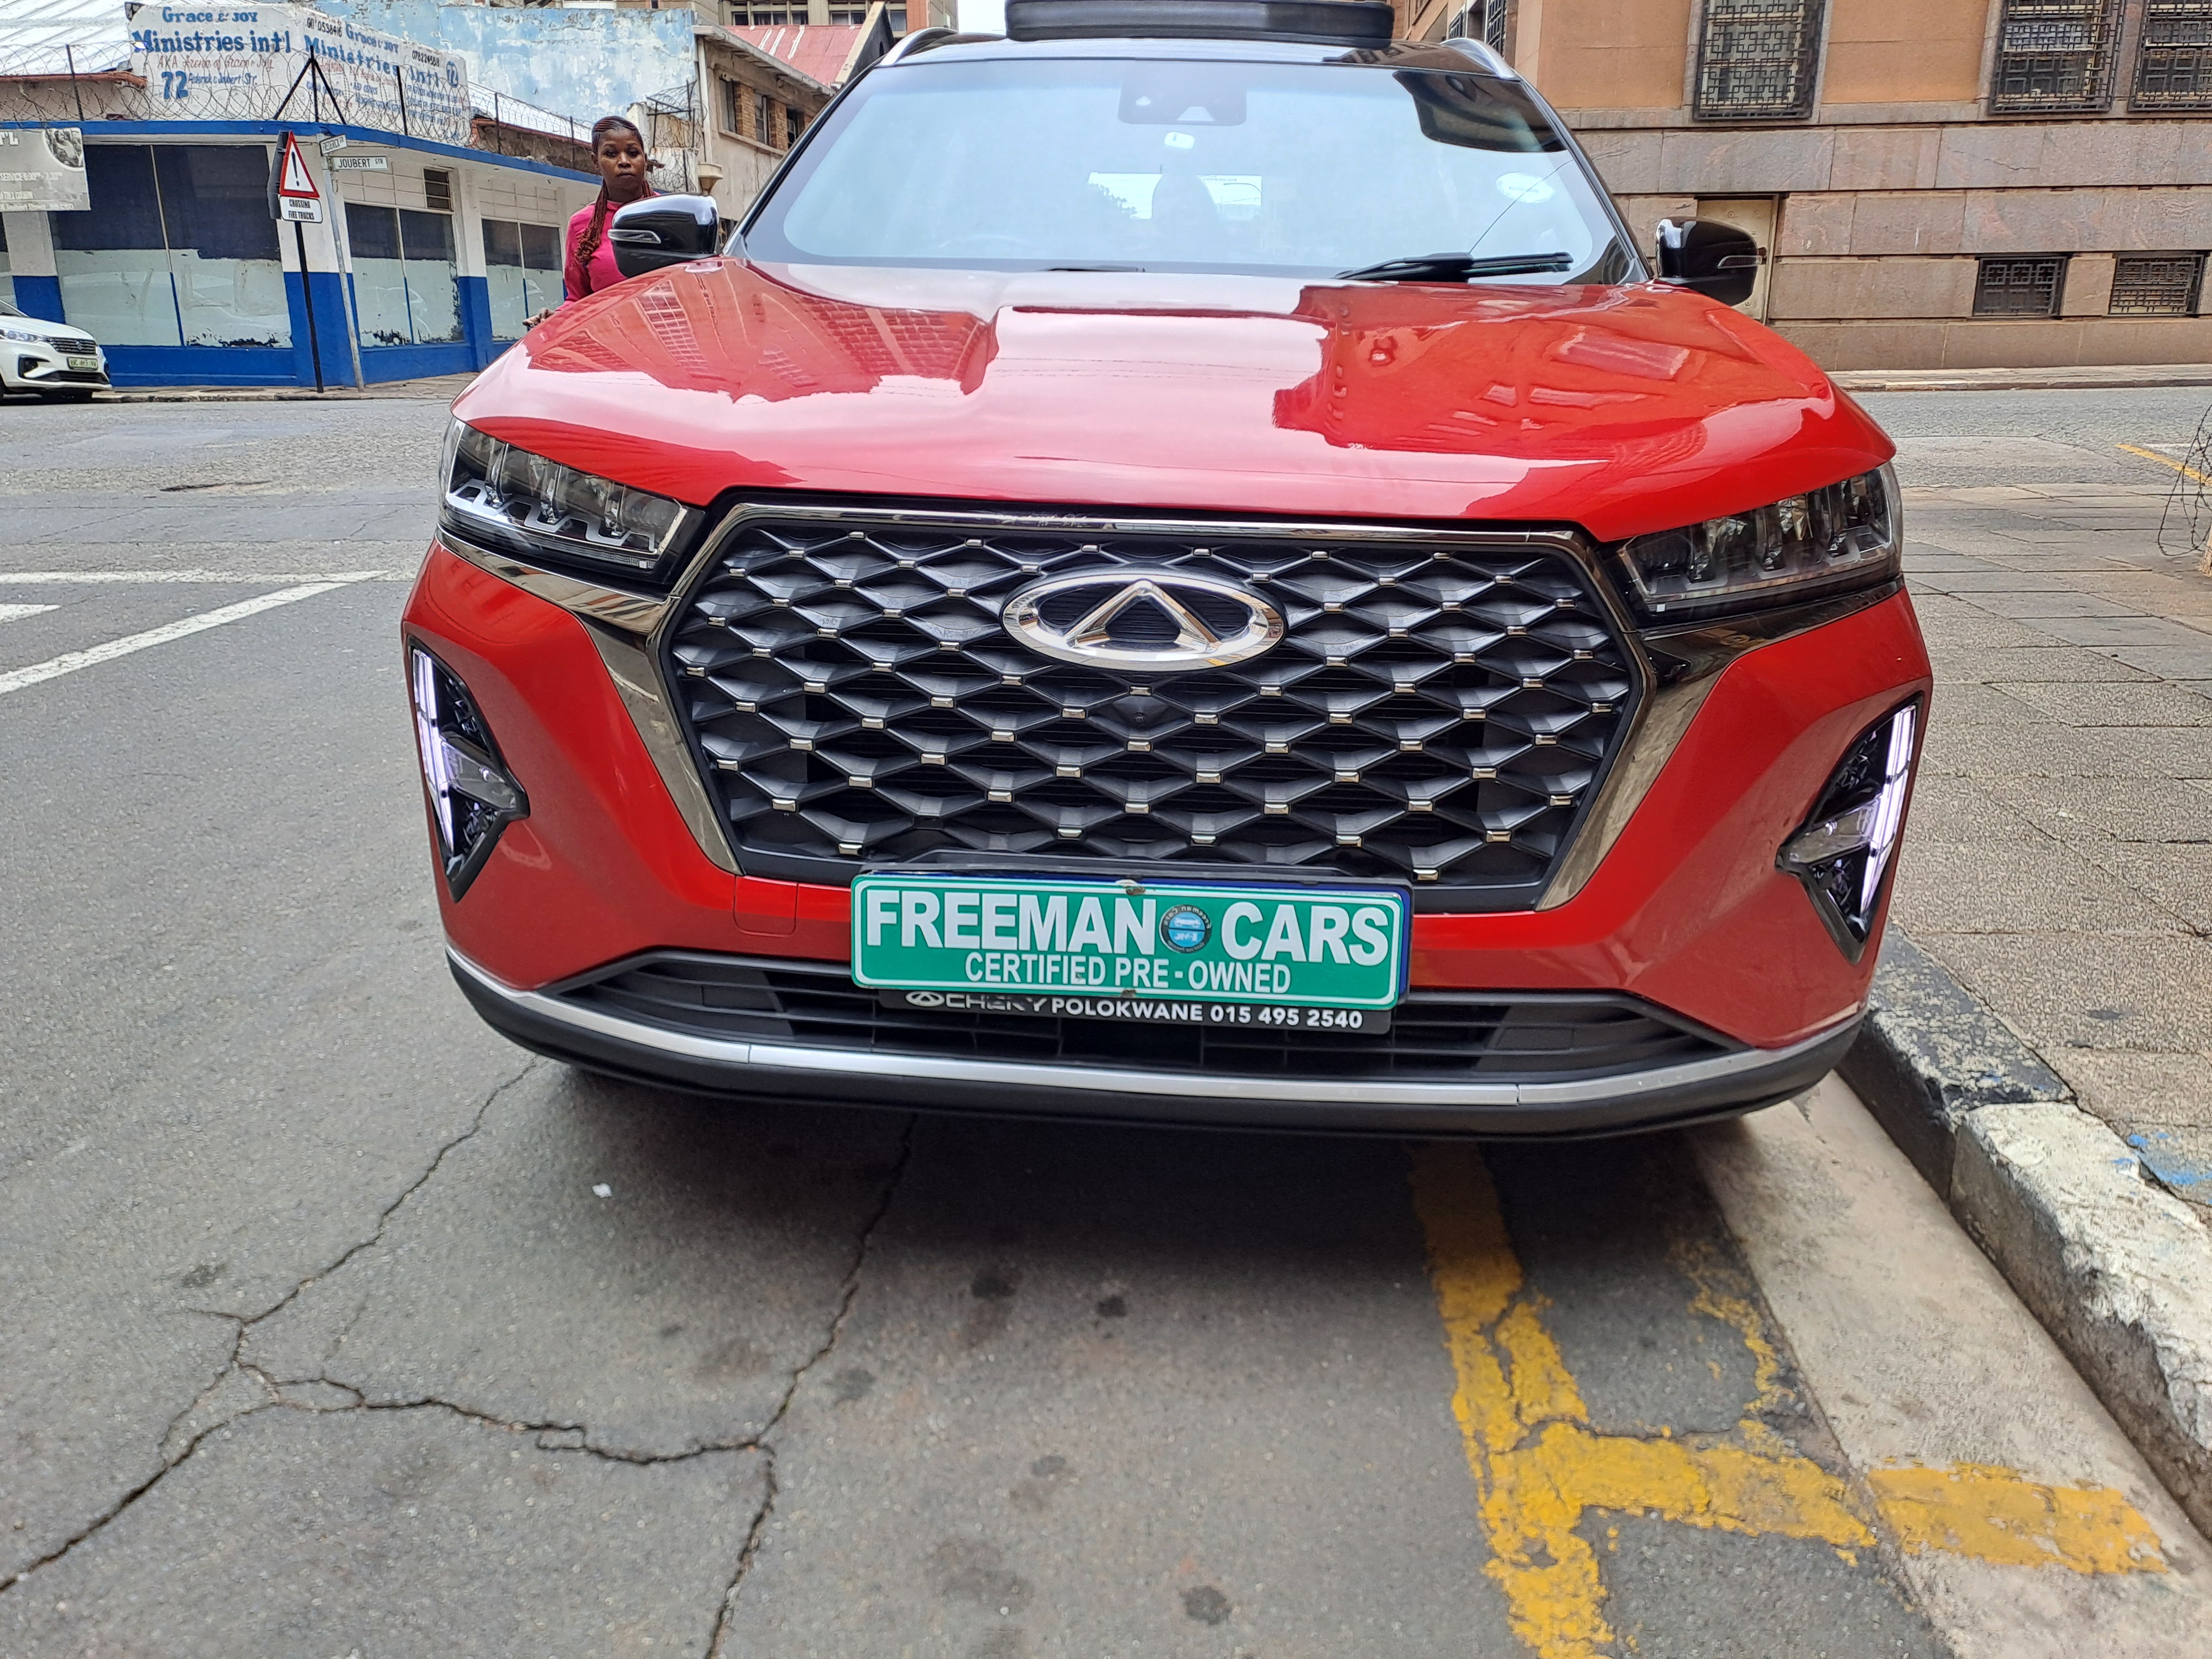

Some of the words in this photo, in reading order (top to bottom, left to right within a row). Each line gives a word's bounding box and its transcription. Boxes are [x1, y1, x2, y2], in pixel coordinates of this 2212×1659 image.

[162, 7, 213, 23] Grace
[132, 30, 244, 53] Ministries
[304, 34, 399, 76] Ministries
[338, 158, 370, 168] JOUBERT
[289, 199, 310, 208] CROSSING
[298, 211, 314, 220] TRUCKS
[867, 889, 1156, 956] FREEMAN
[1221, 901, 1389, 966] CARS
[965, 952, 1106, 985] CERTIFIED
[1051, 997, 1203, 1021] POLOKWANE
[1210, 1005, 1251, 1023] 015
[1258, 1007, 1300, 1025] 495
[1306, 1010, 1363, 1029] 2540
